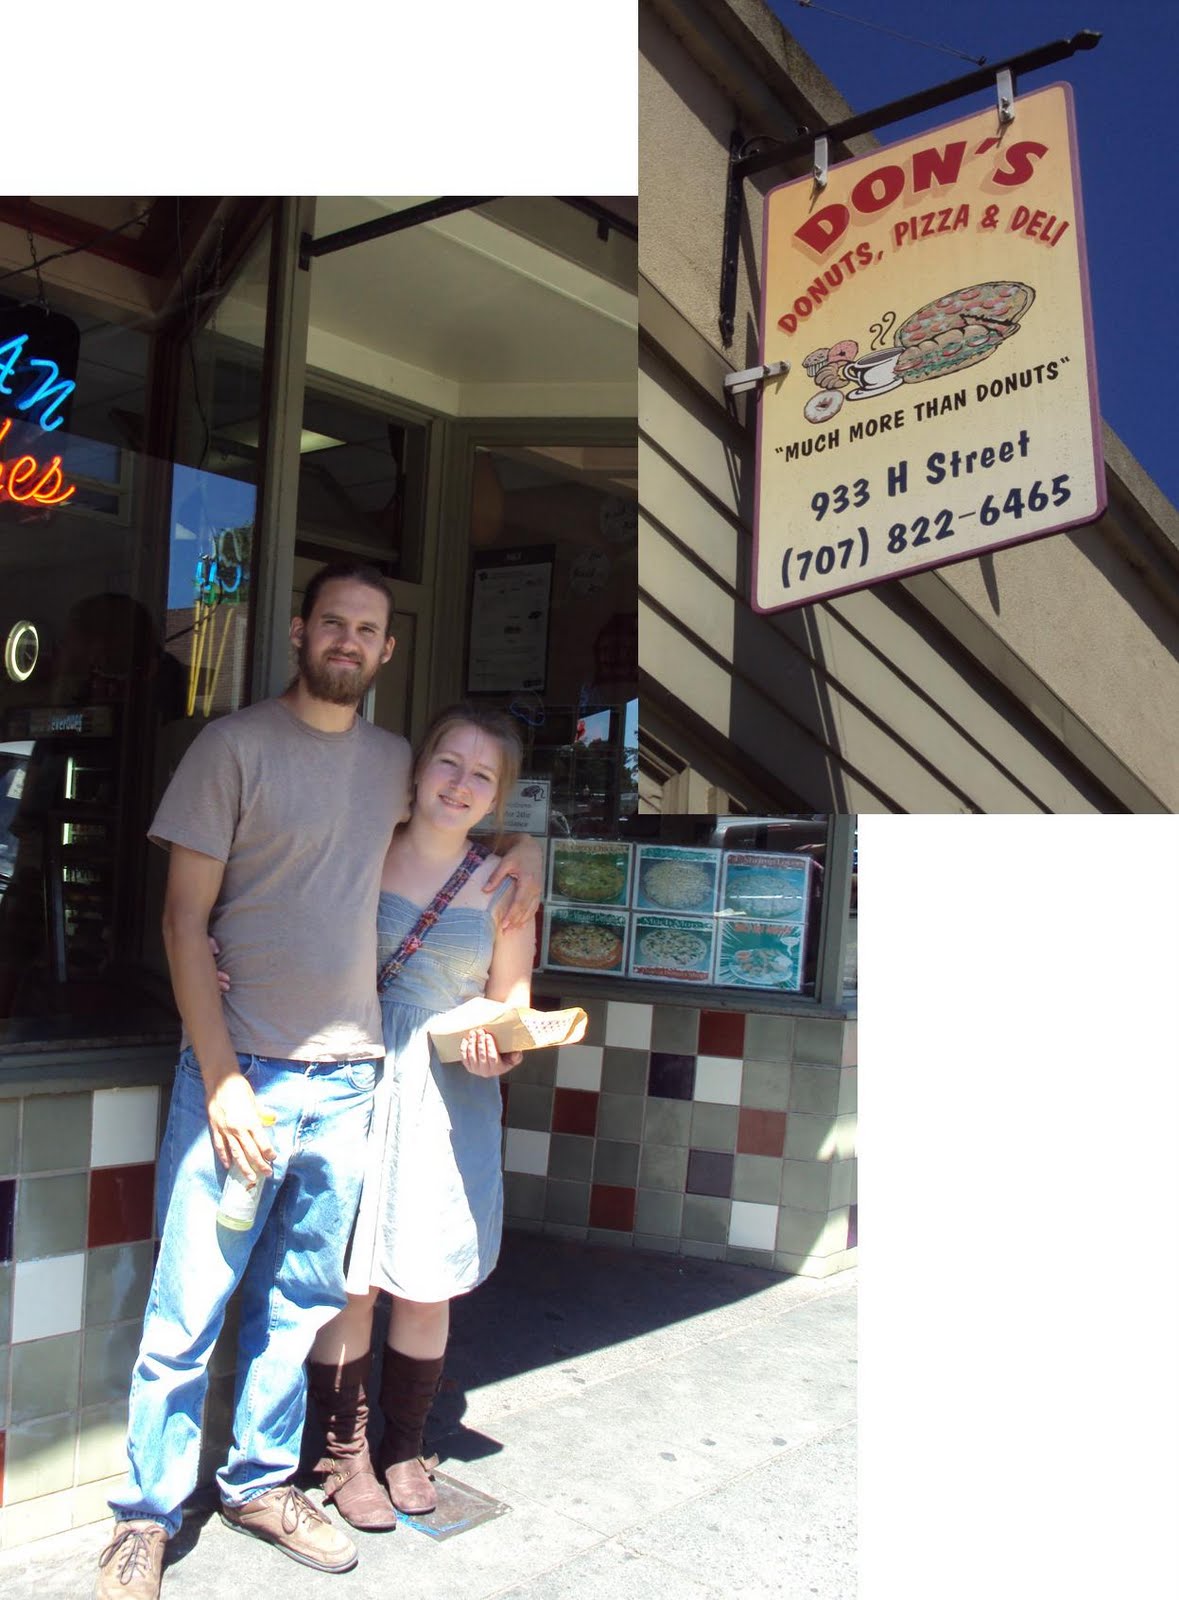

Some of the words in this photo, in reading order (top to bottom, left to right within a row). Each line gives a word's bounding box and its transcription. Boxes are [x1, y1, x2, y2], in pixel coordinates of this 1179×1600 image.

[794, 137, 1049, 255] DON'S
[777, 242, 884, 335] DONUTS,
[895, 204, 969, 246] PIZZA
[981, 204, 999, 227] &
[1011, 205, 1070, 247] DELI
[849, 409, 905, 442] MORE
[913, 390, 967, 422] THAN
[781, 526, 870, 589] (707)
[887, 474, 1072, 554] 822-6465
[811, 479, 870, 522] 933
[887, 460, 908, 497] H
[926, 430, 1031, 485] Street
